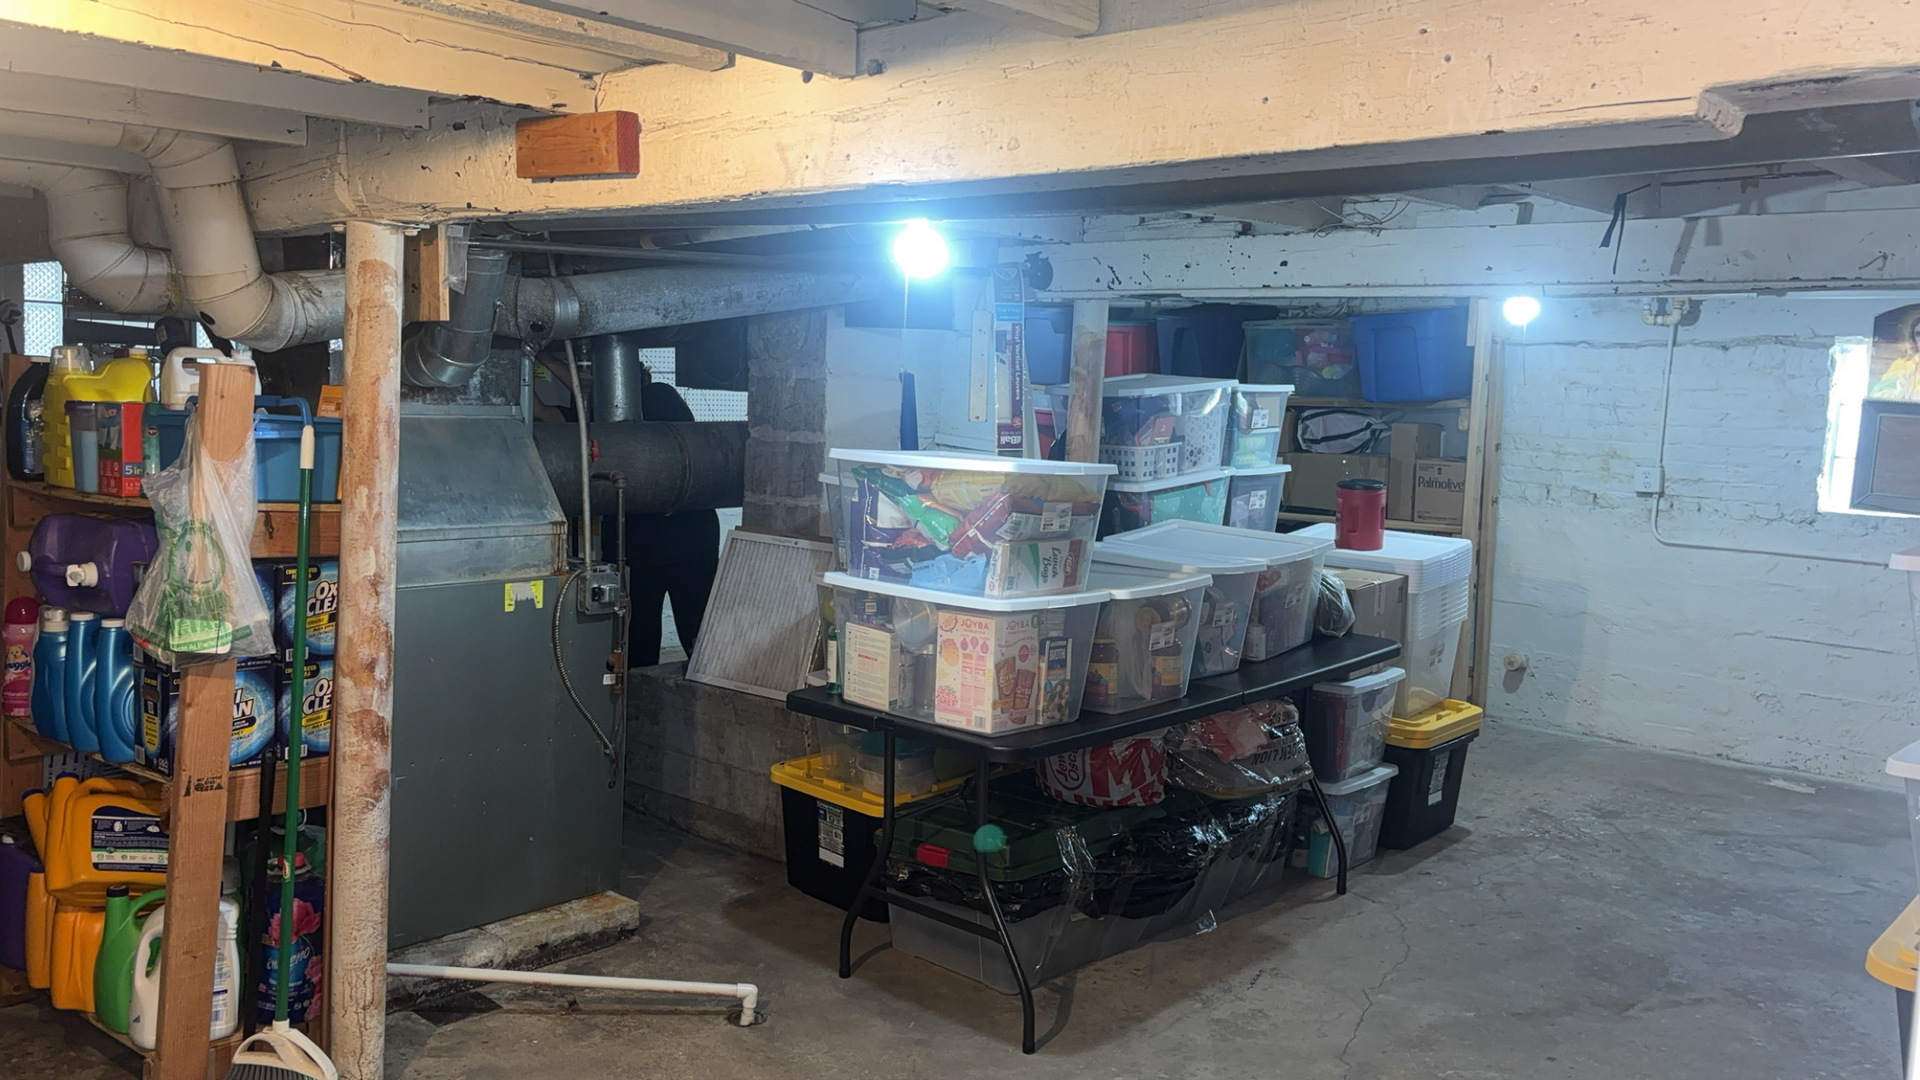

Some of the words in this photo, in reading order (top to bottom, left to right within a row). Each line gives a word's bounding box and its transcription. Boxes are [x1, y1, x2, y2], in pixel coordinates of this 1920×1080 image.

[125, 465, 133, 475] 5
[1418, 475, 1465, 491] Palmolive
[1040, 556, 1052, 584] Bags
[1052, 546, 1061, 580] Lunch
[961, 618, 989, 630] JOYBA
[1007, 620, 1030, 630] JOYBA
[1068, 752, 1080, 781] Osc
